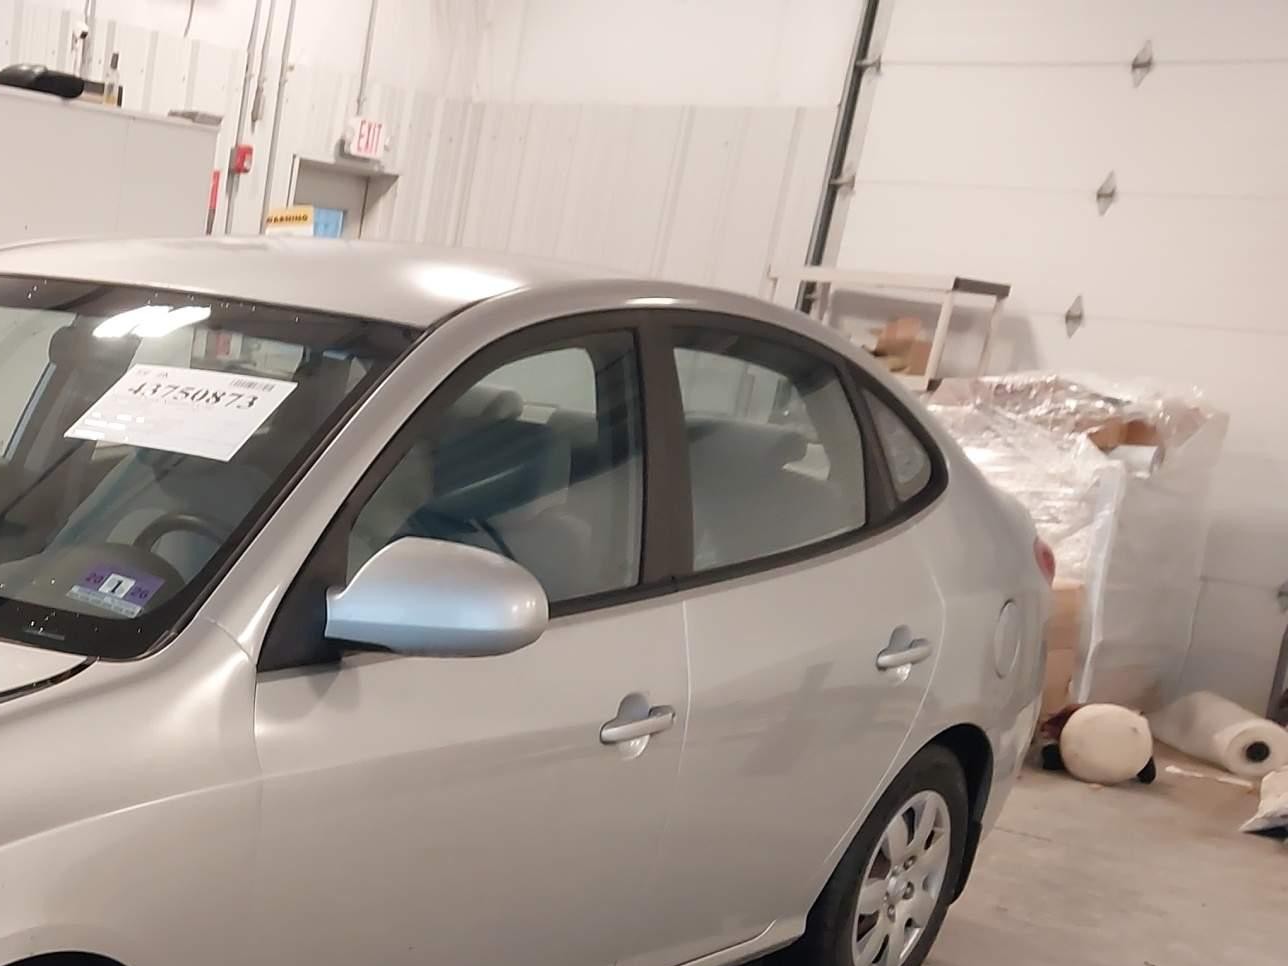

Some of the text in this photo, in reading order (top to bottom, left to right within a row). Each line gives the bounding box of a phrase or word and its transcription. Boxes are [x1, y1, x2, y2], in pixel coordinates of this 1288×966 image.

[357, 120, 382, 154] EXIT
[266, 214, 308, 223] WARNING
[128, 382, 259, 408] 43750873
[111, 580, 122, 592] 1
